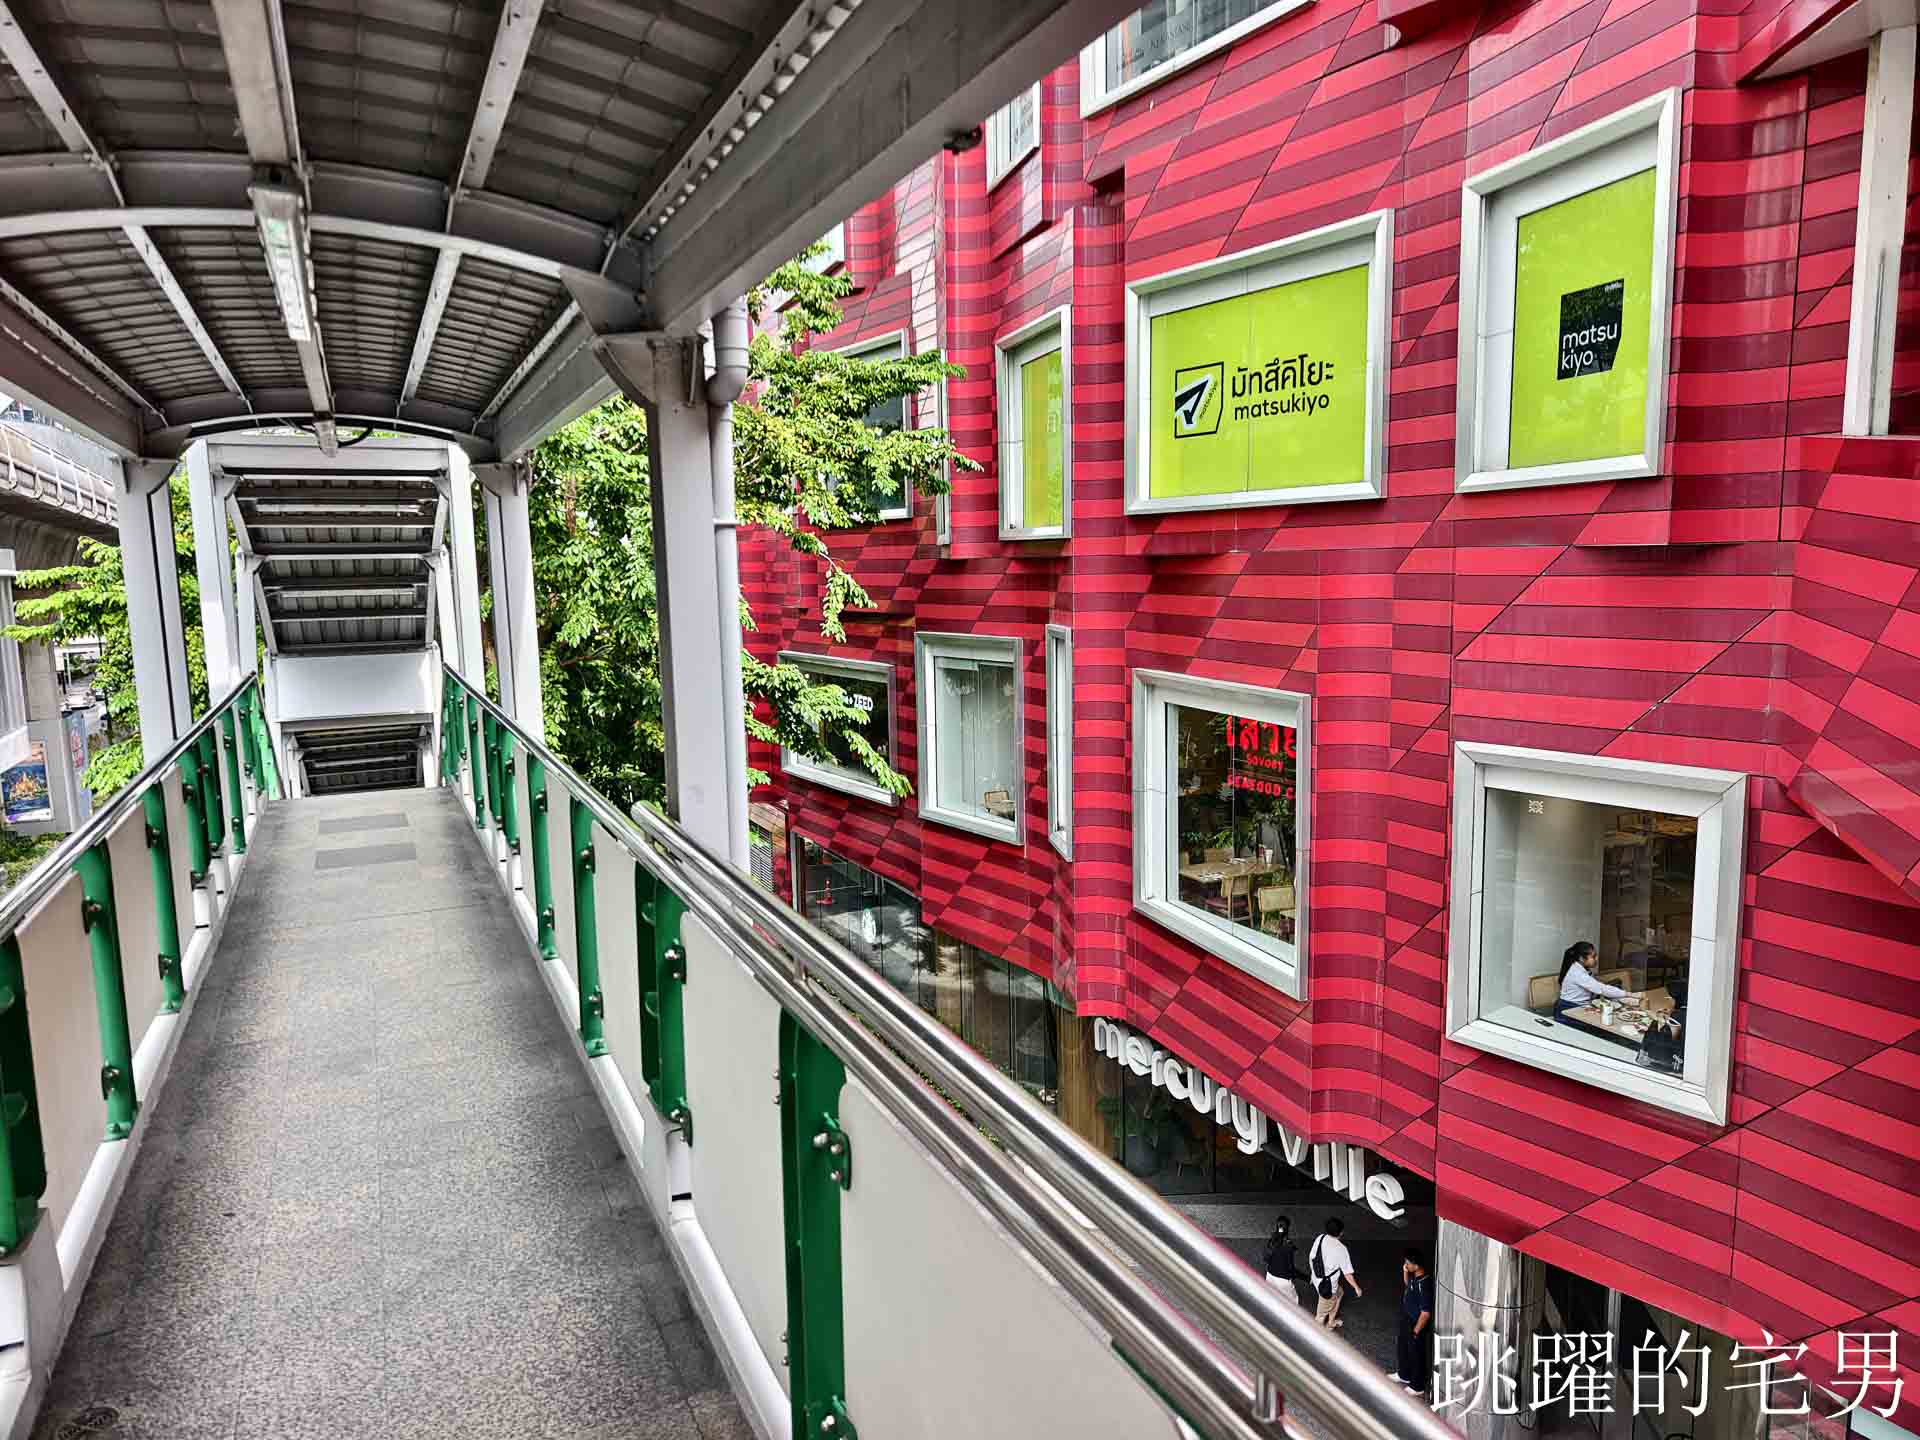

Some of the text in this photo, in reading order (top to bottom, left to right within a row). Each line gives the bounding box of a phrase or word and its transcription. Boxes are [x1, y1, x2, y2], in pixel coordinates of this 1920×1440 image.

[1562, 322, 1618, 349] matsu
[1232, 354, 1335, 398] มัทสึคิโยะ
[1561, 349, 1593, 377] kiyo
[1234, 391, 1330, 420] matsukiyo
[1093, 1017, 1267, 1155] mercury
